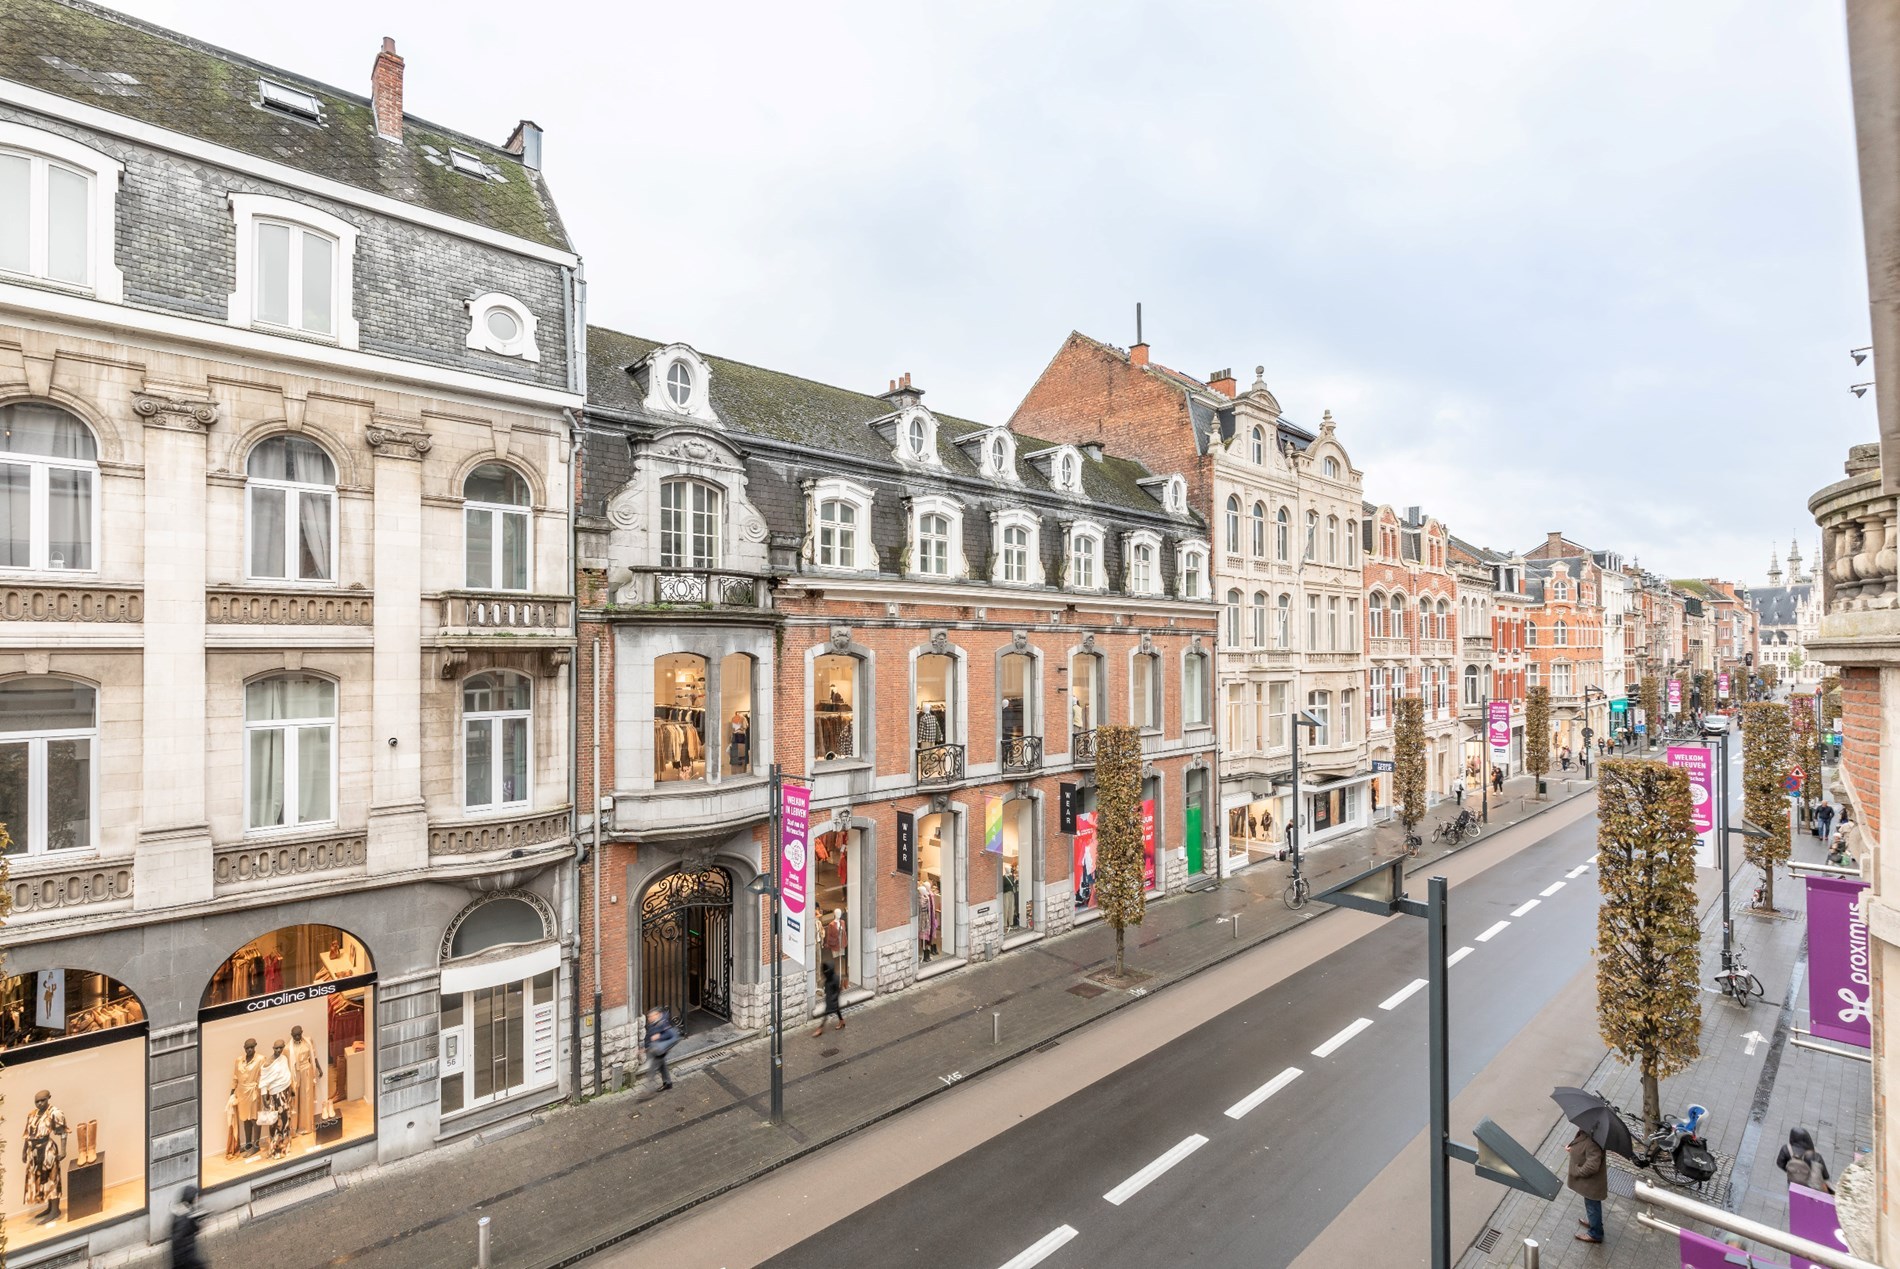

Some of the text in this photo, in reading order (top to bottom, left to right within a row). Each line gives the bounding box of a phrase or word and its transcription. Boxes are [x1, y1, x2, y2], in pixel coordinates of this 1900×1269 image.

[247, 984, 336, 1011] caroline biss
[446, 1058, 456, 1067] 56
